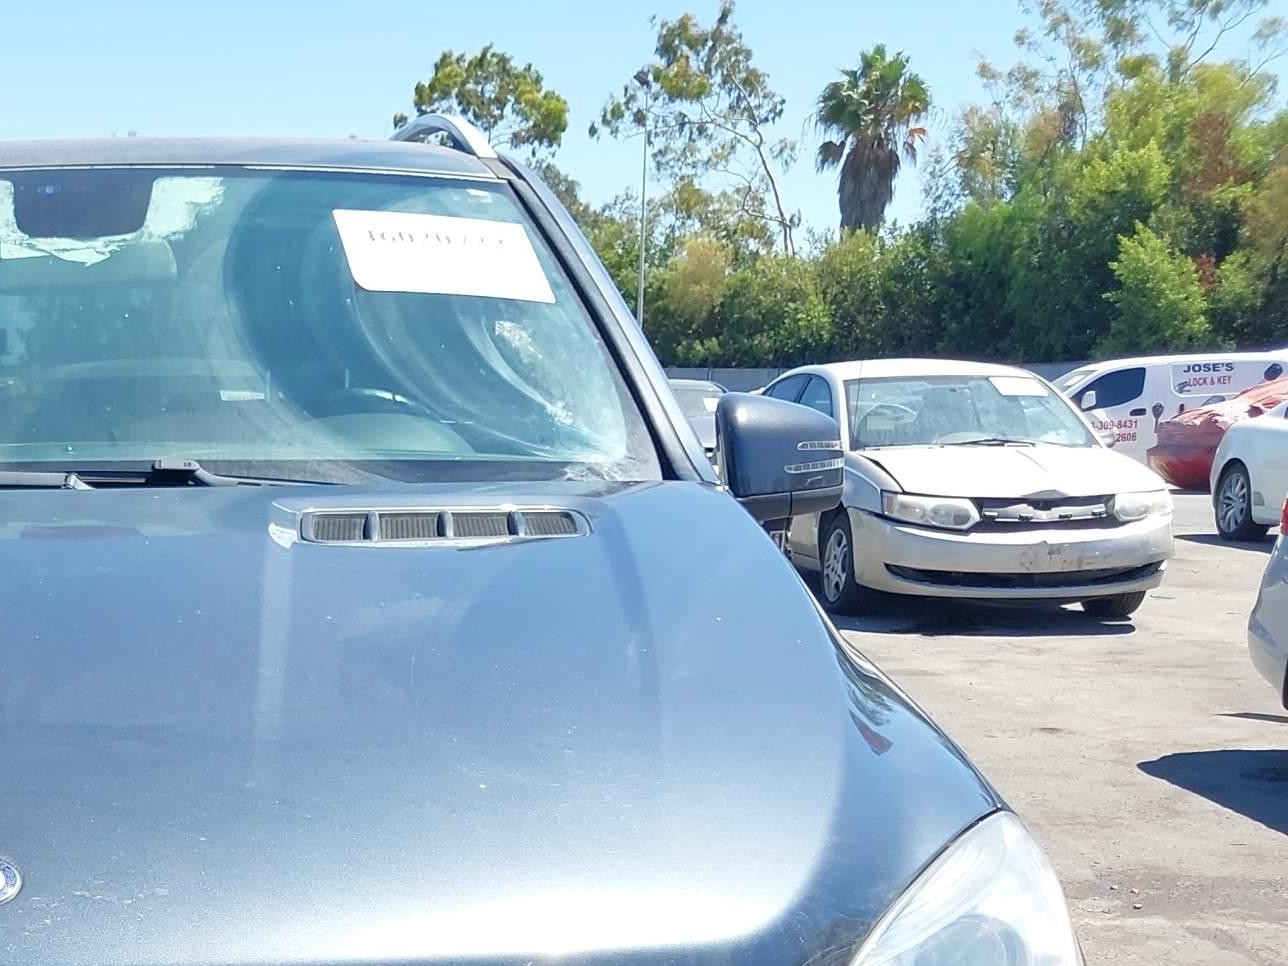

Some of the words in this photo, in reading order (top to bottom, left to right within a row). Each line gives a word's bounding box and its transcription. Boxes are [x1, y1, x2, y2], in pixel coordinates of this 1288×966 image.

[1183, 362, 1234, 373] JOSE'S
[1188, 376, 1208, 387] LOCK
[1210, 376, 1215, 386] &
[1218, 375, 1232, 385] KEY
